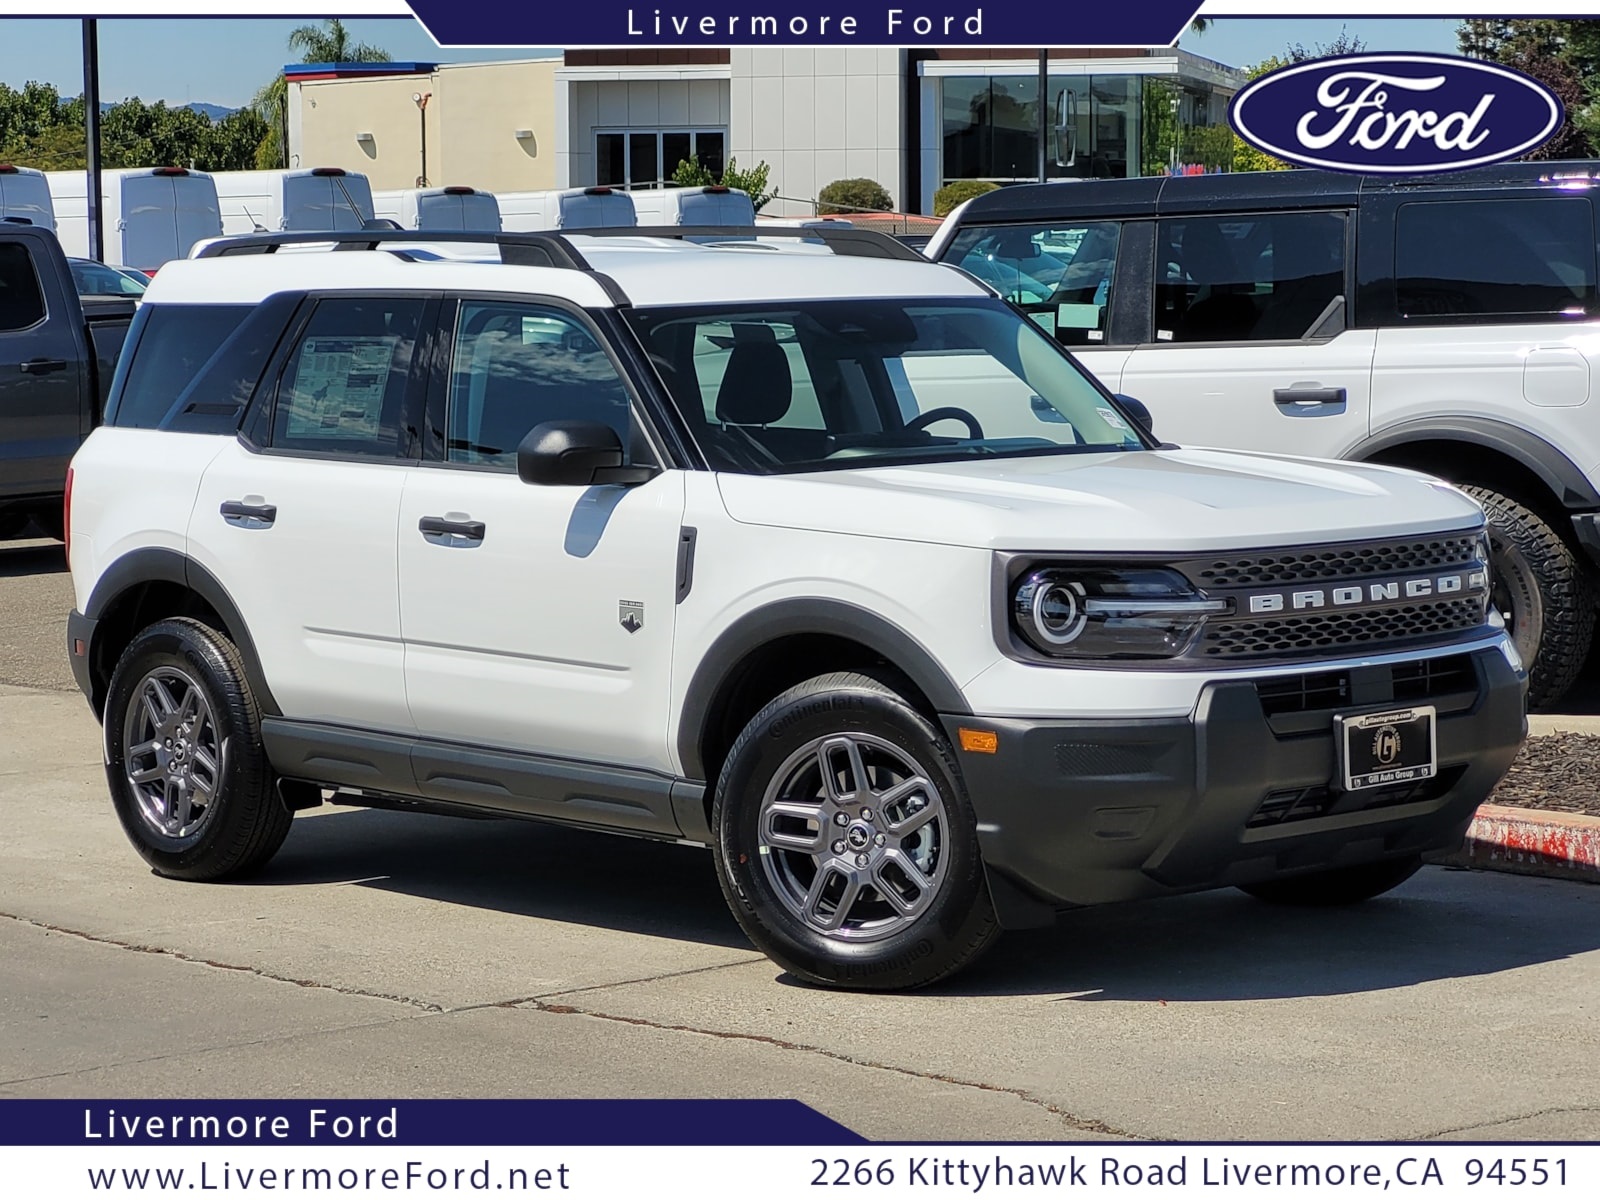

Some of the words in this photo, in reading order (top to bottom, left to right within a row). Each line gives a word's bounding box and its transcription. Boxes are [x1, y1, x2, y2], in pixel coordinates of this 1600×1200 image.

[1250, 576, 1462, 612] BRONCO
[770, 696, 853, 737] Continental
[1365, 712, 1411, 725] gillautogroup.com
[1368, 775, 1379, 784] Gill
[1380, 774, 1394, 782] Auto
[1395, 771, 1414, 779] Group
